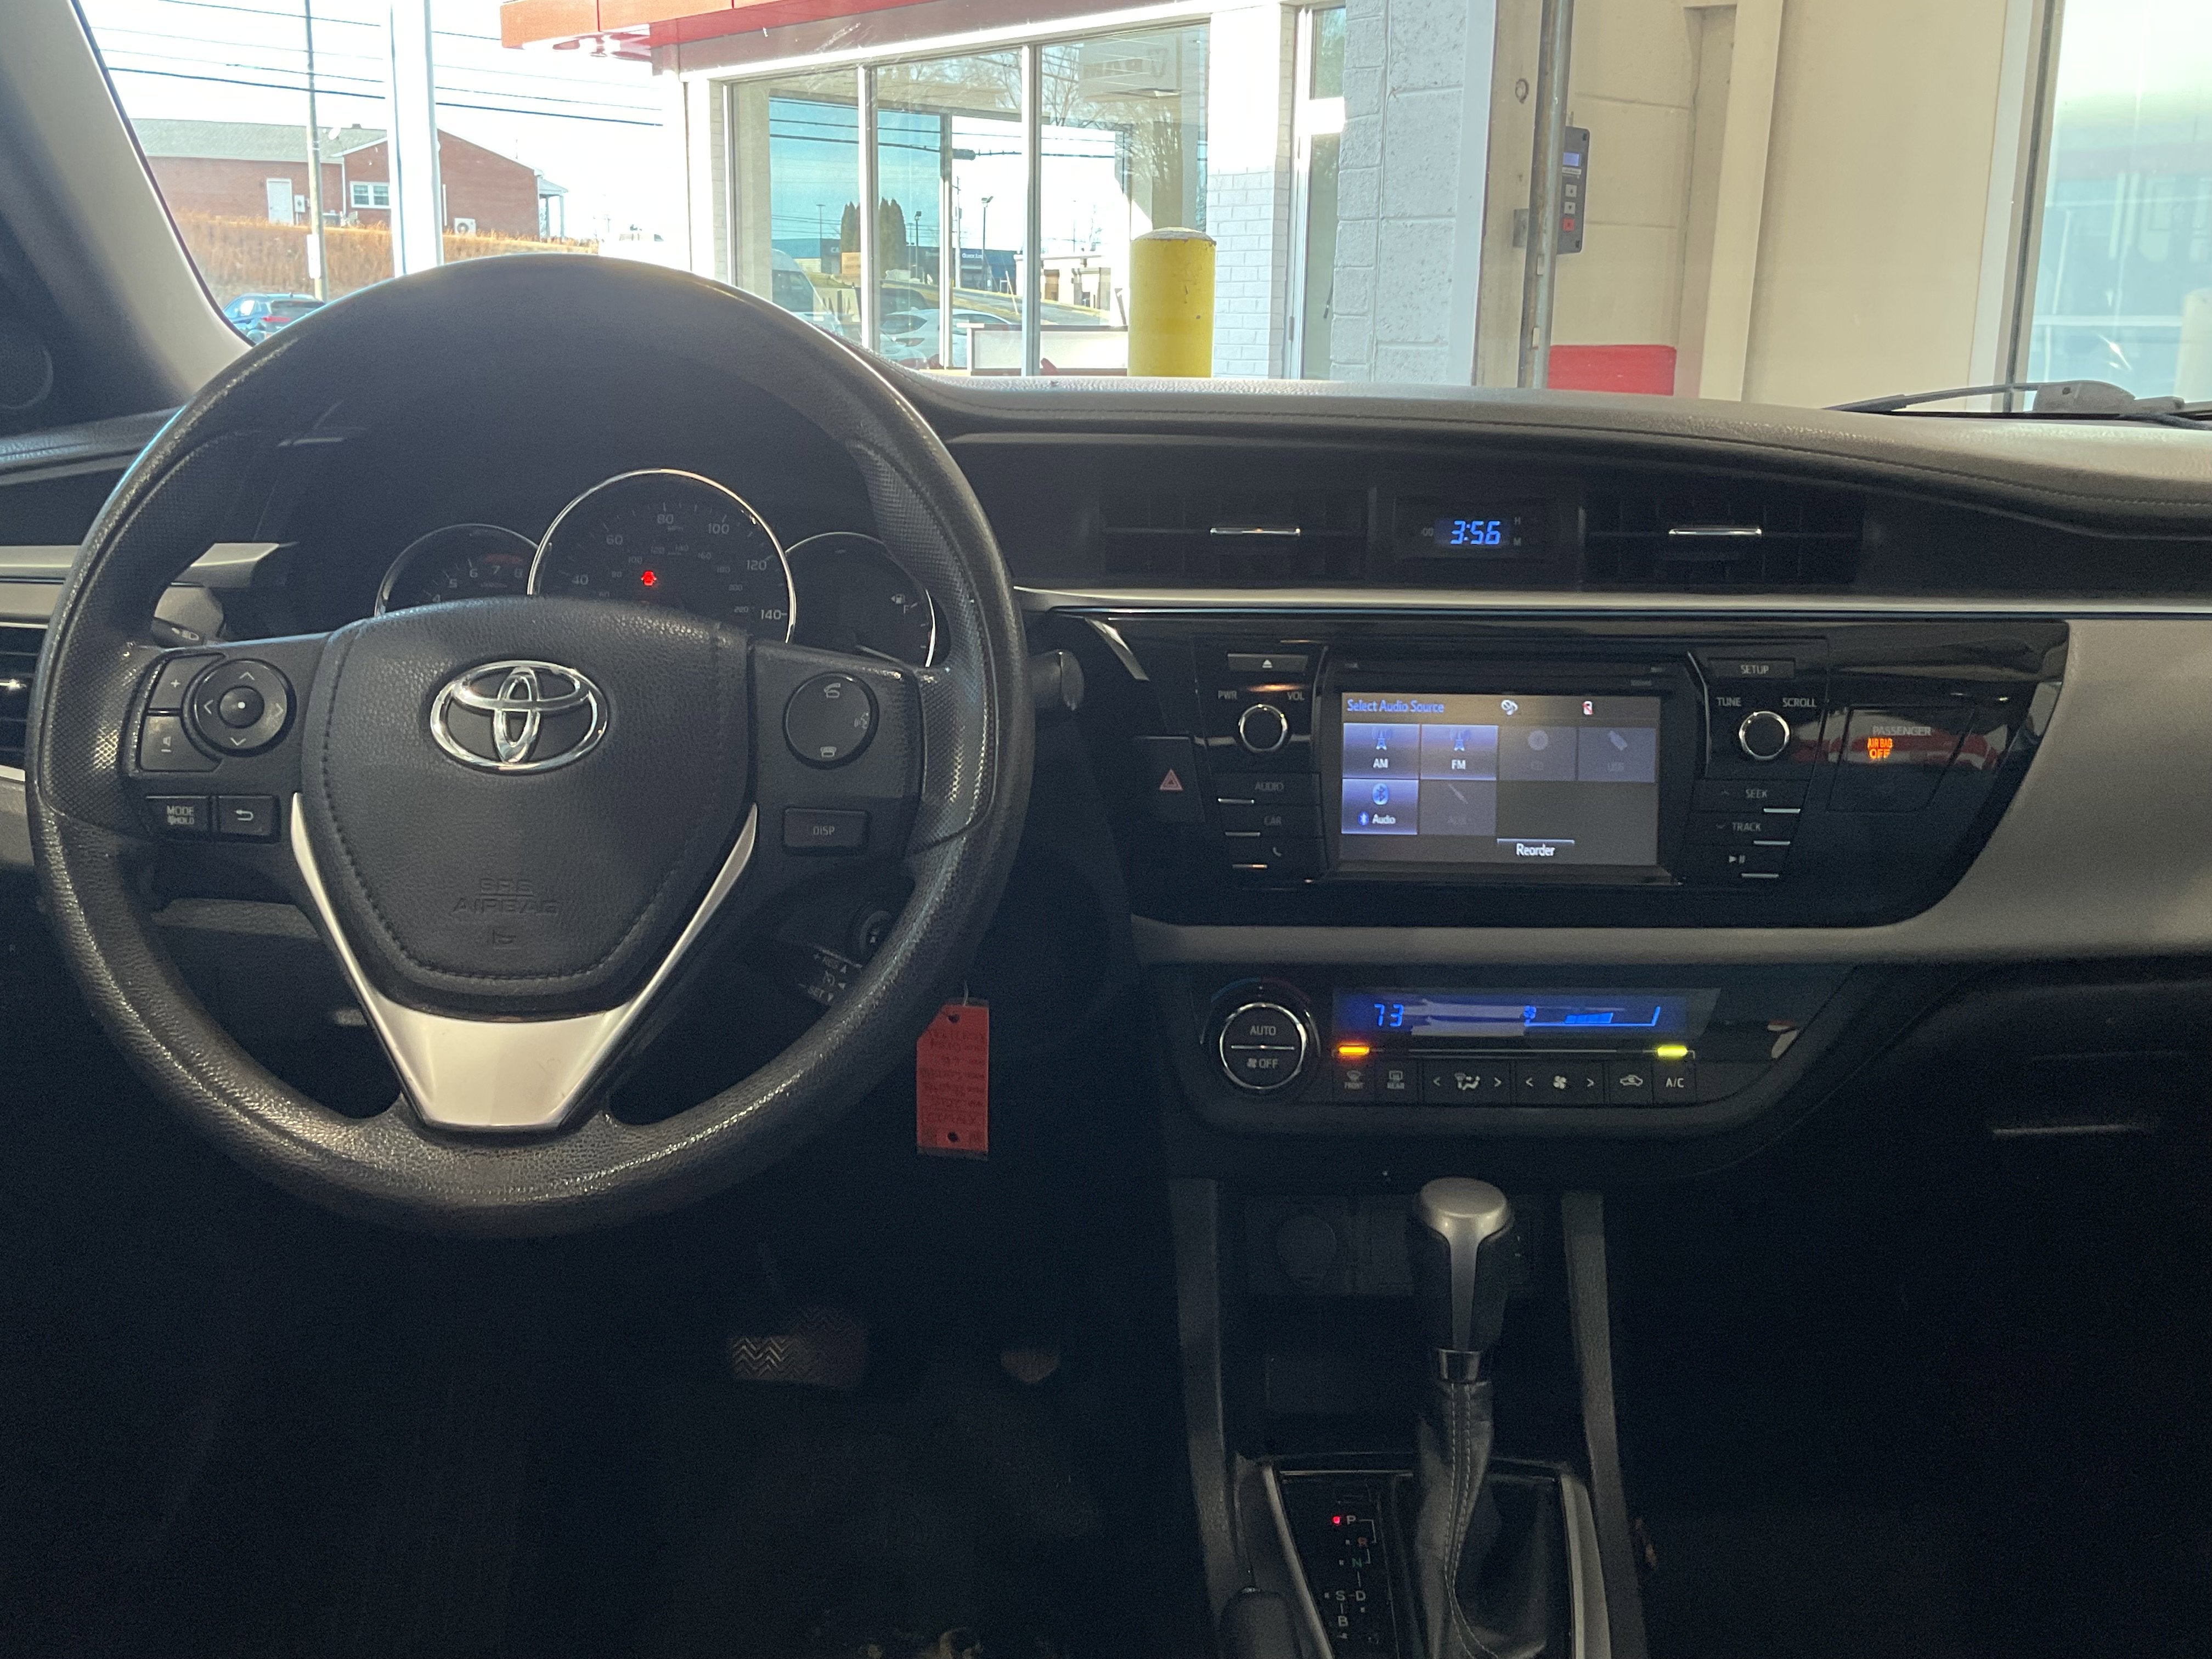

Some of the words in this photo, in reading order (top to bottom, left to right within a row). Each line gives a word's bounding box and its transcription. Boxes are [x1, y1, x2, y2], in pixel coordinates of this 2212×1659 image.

[657, 514, 674, 524] 80
[708, 523, 730, 534] 100
[1450, 519, 1500, 544] 3:56
[606, 534, 623, 545] 60
[491, 565, 501, 575] 7
[746, 559, 767, 571] 120
[469, 568, 478, 578] 6
[448, 578, 458, 588] 5
[572, 574, 589, 585] 40
[760, 608, 782, 620] 140
[1740, 664, 1770, 675] SETUP
[1217, 690, 1238, 700] PWR
[1286, 691, 1305, 701] VOL
[1347, 698, 1377, 712] Select
[1379, 698, 1408, 712] Audio
[1410, 699, 1444, 713] Source
[1716, 697, 1742, 707] TUNE
[1782, 697, 1818, 708] SCROLL
[1872, 725, 1932, 736] PASSENGER
[1867, 737, 1879, 748] AIR
[1880, 738, 1893, 748] BAG
[1869, 748, 1891, 759] OFF
[1373, 758, 1389, 769] AM
[1451, 759, 1466, 769] FM
[1255, 781, 1284, 792] AUDIO
[1745, 788, 1768, 798] SEEK
[166, 805, 195, 816] MODE
[1264, 816, 1282, 826] CAR
[1372, 814, 1397, 825] Audio
[812, 825, 835, 836] DISP
[1732, 821, 1762, 832] TRACK
[1515, 843, 1555, 857] Reorder
[1374, 1003, 1404, 1027] 73
[1250, 1025, 1277, 1036] AUTO
[1258, 1058, 1279, 1069] OFF
[1665, 1076, 1685, 1088] A/C
[1346, 1515, 1357, 1525] P
[1352, 1557, 1363, 1568] N
[1335, 1590, 1346, 1601] S
[1355, 1590, 1367, 1601] D
[1337, 1615, 1349, 1627] B
